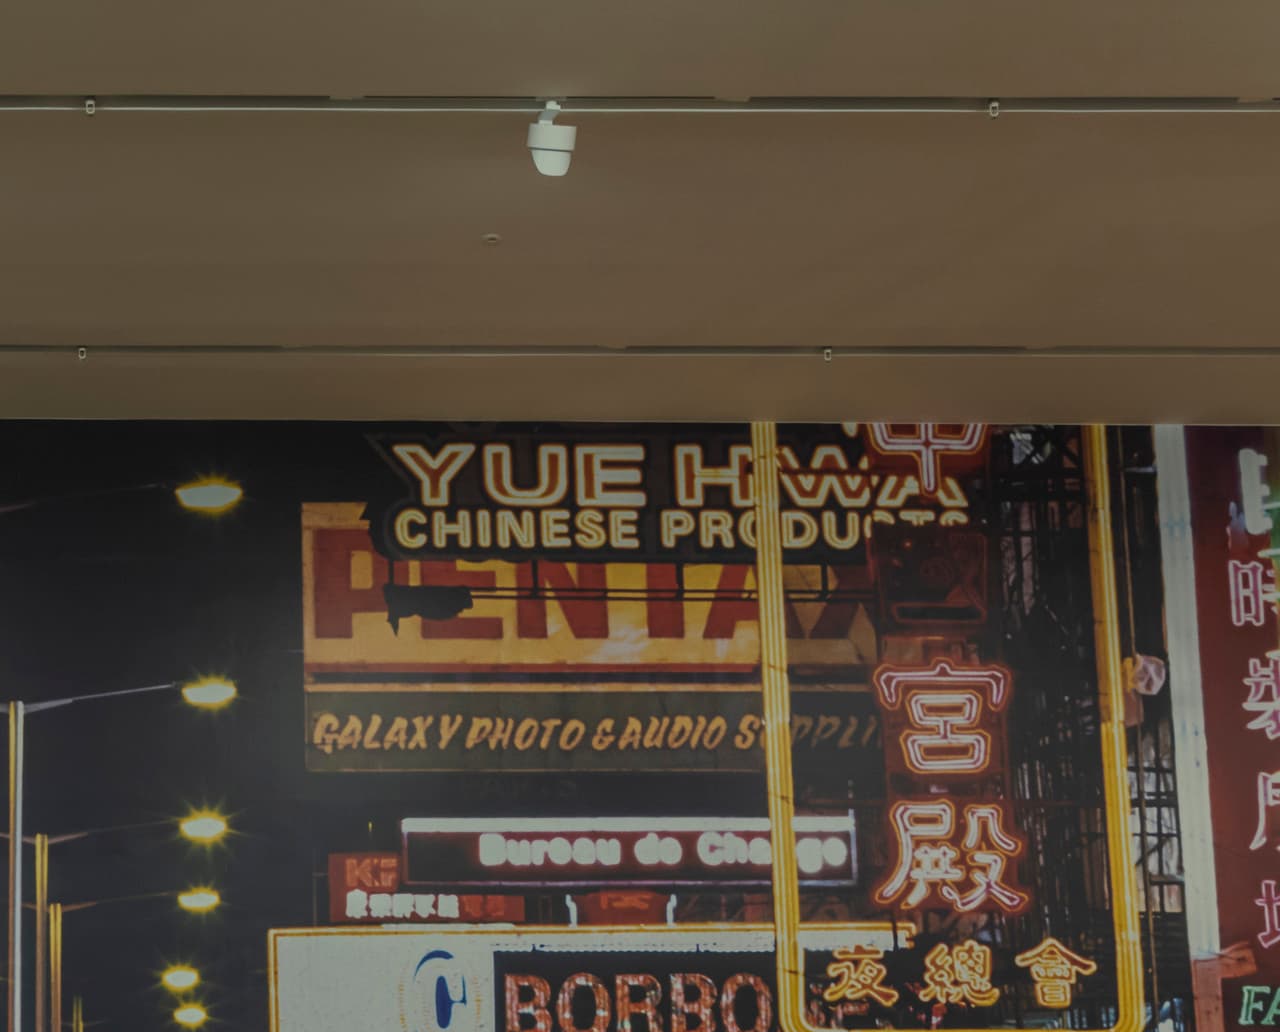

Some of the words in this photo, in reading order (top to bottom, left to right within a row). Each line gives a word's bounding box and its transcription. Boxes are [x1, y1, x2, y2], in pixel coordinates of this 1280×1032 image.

[392, 444, 646, 507] YUE
[394, 509, 640, 548] CHINESE
[313, 712, 463, 754] GALAXY
[465, 716, 586, 751] PHOTO
[622, 715, 725, 750] AUDIO
[733, 712, 884, 750] SPPLI
[478, 832, 623, 866] Bureau
[633, 832, 683, 865] de
[696, 832, 849, 873] Chage
[823, 937, 1097, 1009] 夜總會
